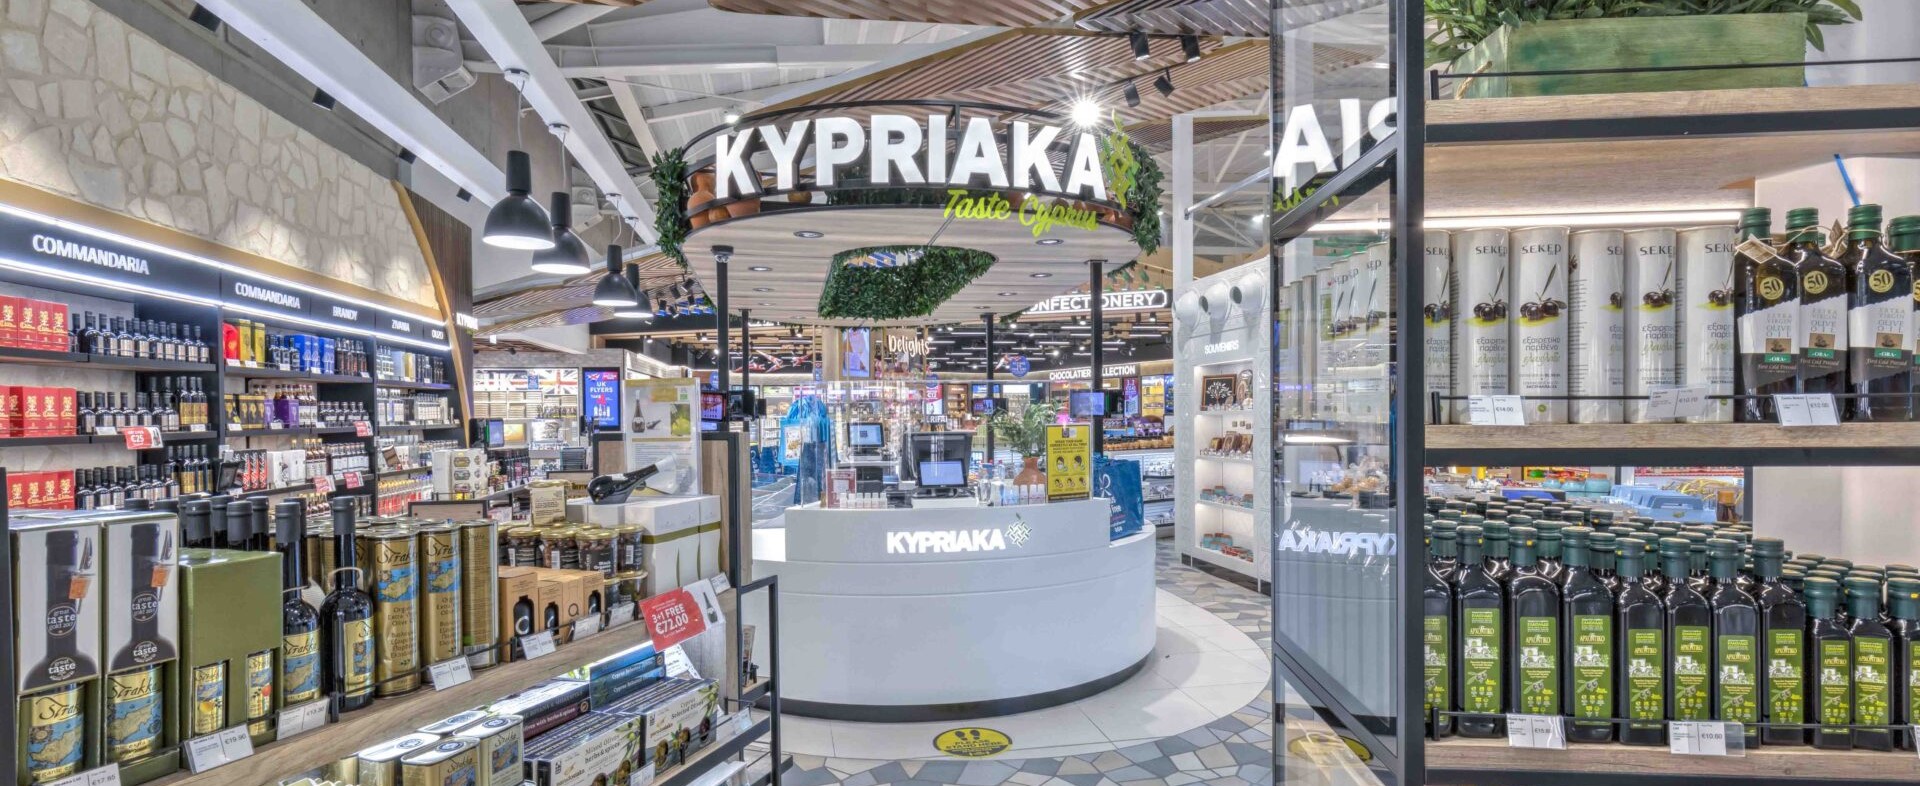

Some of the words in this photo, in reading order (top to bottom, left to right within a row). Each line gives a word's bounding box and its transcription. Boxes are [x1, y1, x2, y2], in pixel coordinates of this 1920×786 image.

[716, 114, 1108, 200] KYPRIAKA
[943, 189, 1011, 219] Taste
[1019, 194, 1099, 237] Cyprus
[32, 234, 150, 275] COMMANDARIA
[1763, 279, 1781, 294] 50
[1807, 274, 1824, 289] 50
[1873, 272, 1891, 287] 50
[235, 282, 301, 309] COMMANDARIA
[332, 306, 358, 321] BRANDY
[391, 319, 410, 332] ZIVANIA
[431, 330, 444, 340] OUZO
[888, 334, 930, 358] Delights
[1204, 340, 1239, 355] SOUVENIRS
[1049, 368, 1092, 380] CHOCOLATIER
[1102, 365, 1136, 377] LLECTION
[131, 434, 144, 443] €25
[887, 529, 1006, 554] KYPRIAKA
[132, 600, 157, 611] taste
[47, 614, 76, 625] taste
[652, 613, 666, 624] 3+1
[665, 603, 686, 618] FREE
[656, 613, 689, 634] €72.00
[133, 646, 158, 657] taste
[48, 664, 76, 675] taste
